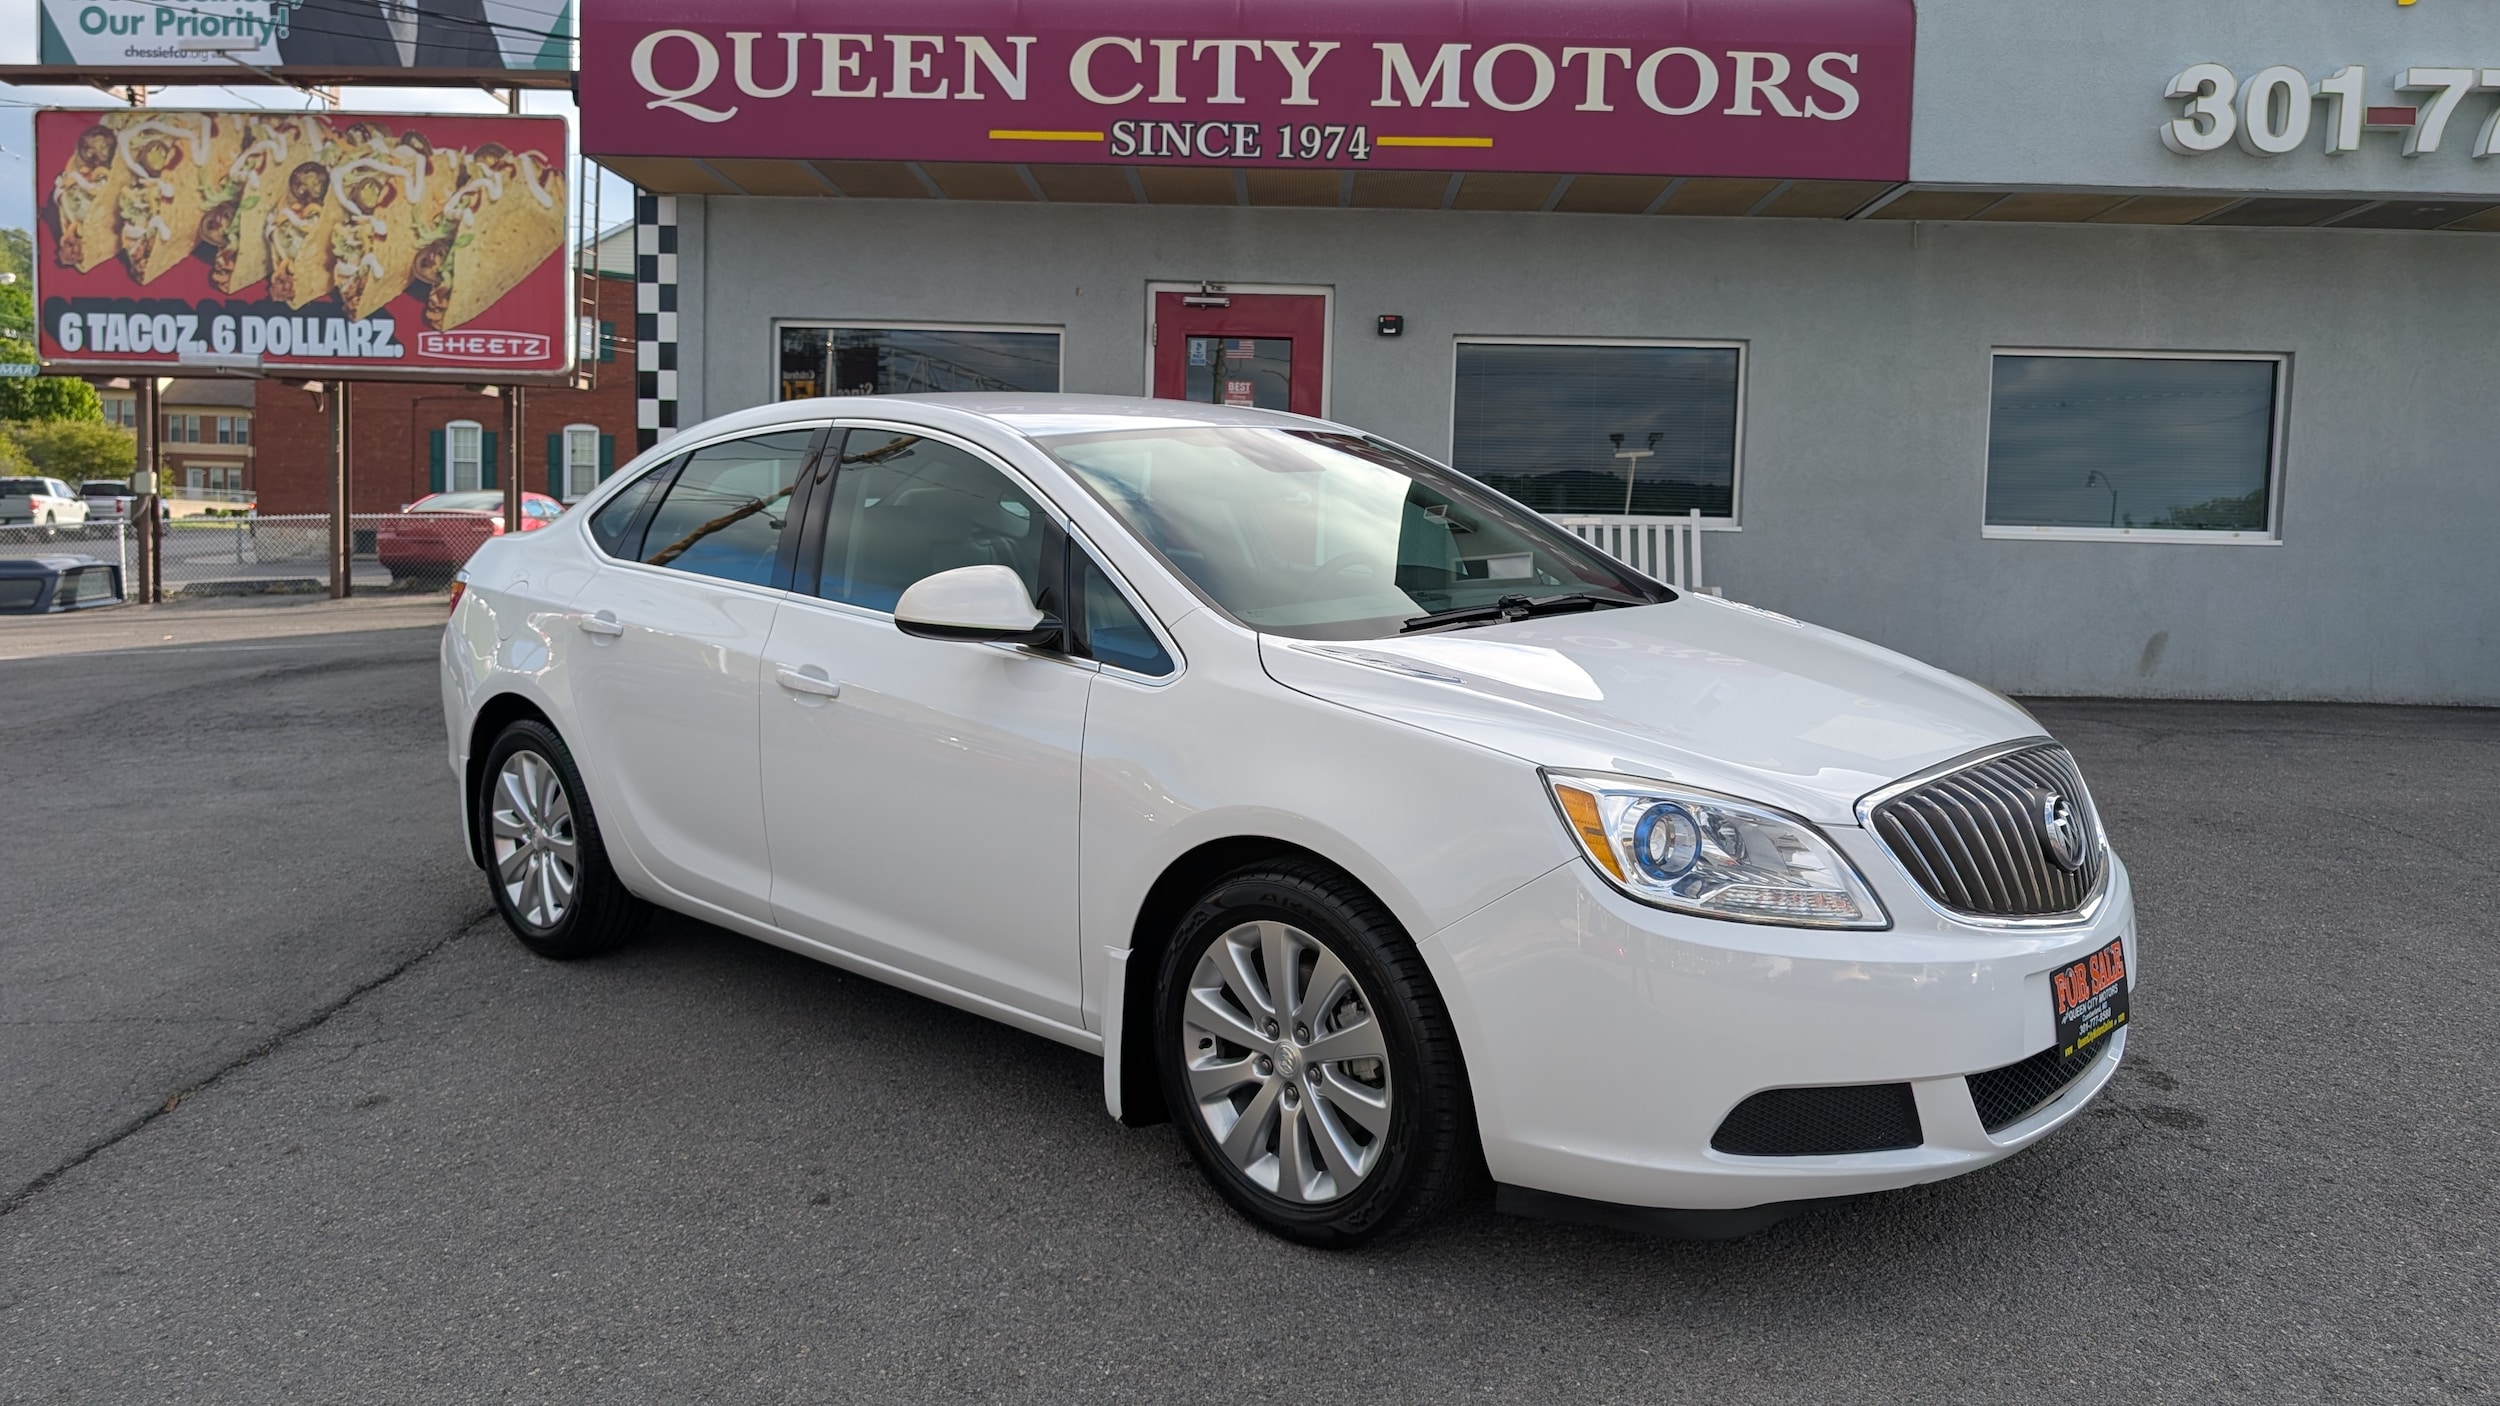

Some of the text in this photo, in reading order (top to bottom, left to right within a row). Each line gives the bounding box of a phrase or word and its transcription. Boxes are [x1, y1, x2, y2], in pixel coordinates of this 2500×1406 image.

[79, 6, 290, 46] Our Priority!
[630, 28, 1861, 124] QUEEN CITY MOTORS
[1111, 119, 1371, 161] SINCE 1974
[59, 312, 83, 352] 6
[212, 315, 237, 354] 6
[241, 315, 405, 358] DOLLARZ.
[427, 336, 540, 355] SHEETZ
[1228, 381, 1252, 392] BEST
[2054, 940, 2125, 1015] FOR SALE
